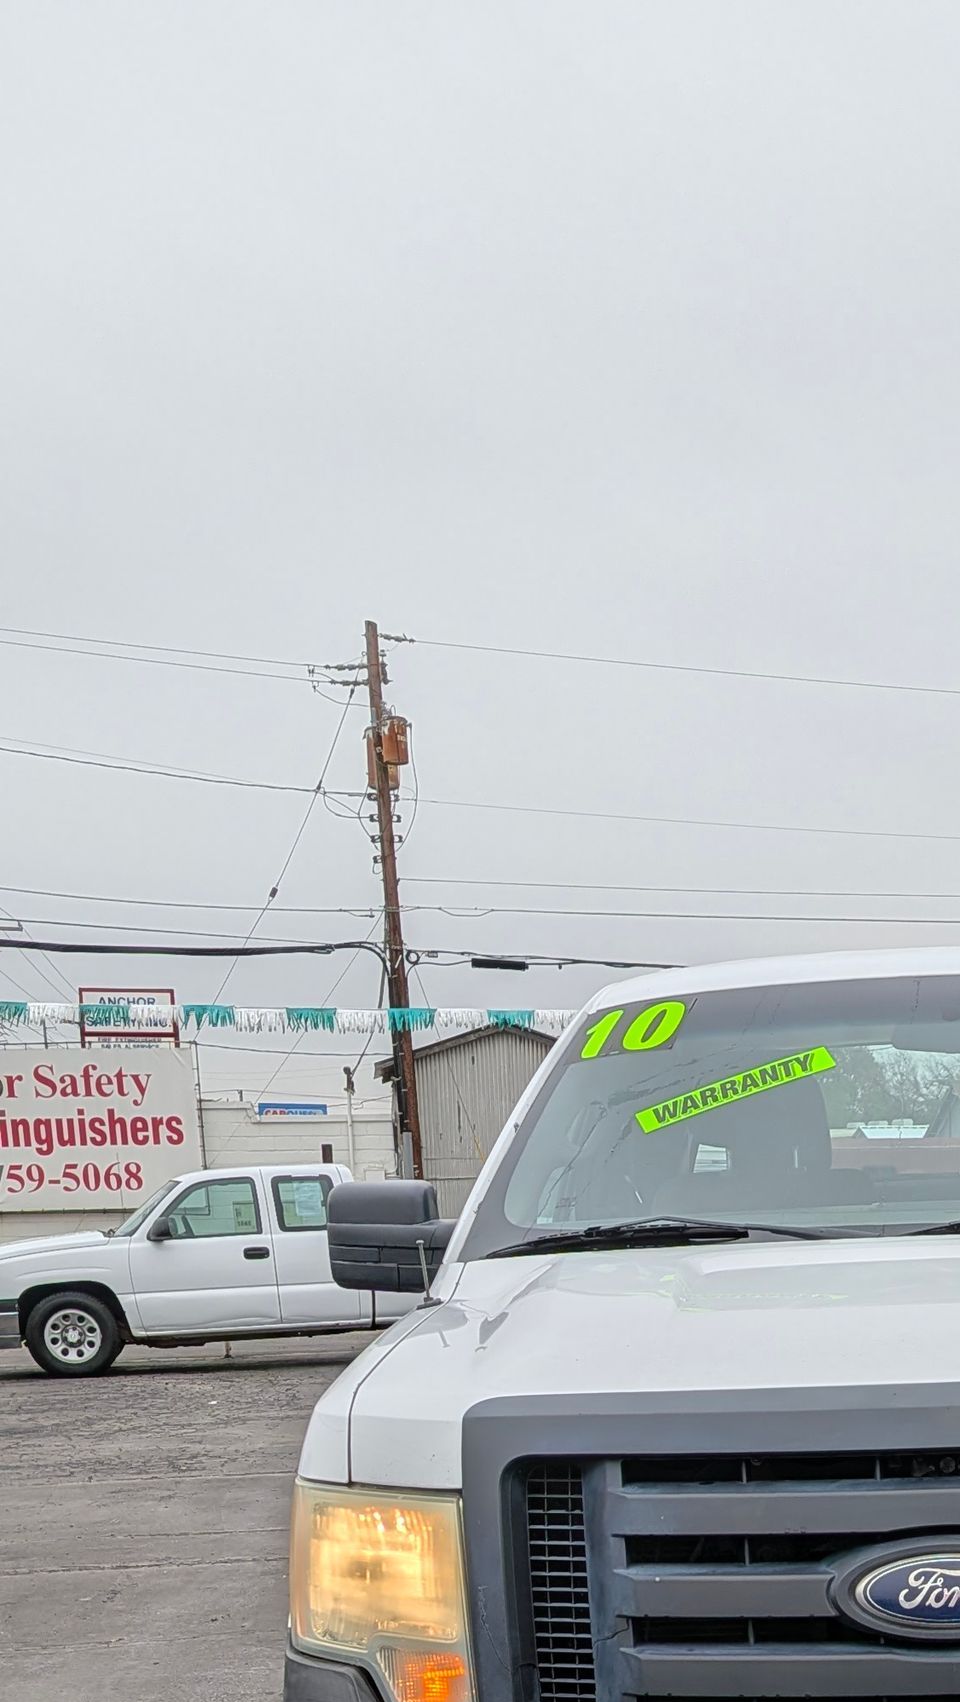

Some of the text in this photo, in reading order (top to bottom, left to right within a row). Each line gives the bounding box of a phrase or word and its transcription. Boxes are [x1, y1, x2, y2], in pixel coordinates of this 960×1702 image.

[580, 1001, 686, 1059] 10
[0, 1064, 152, 1106] r Safety
[652, 1053, 815, 1125] WARRANTY
[0, 1161, 144, 1193] 59-5068
